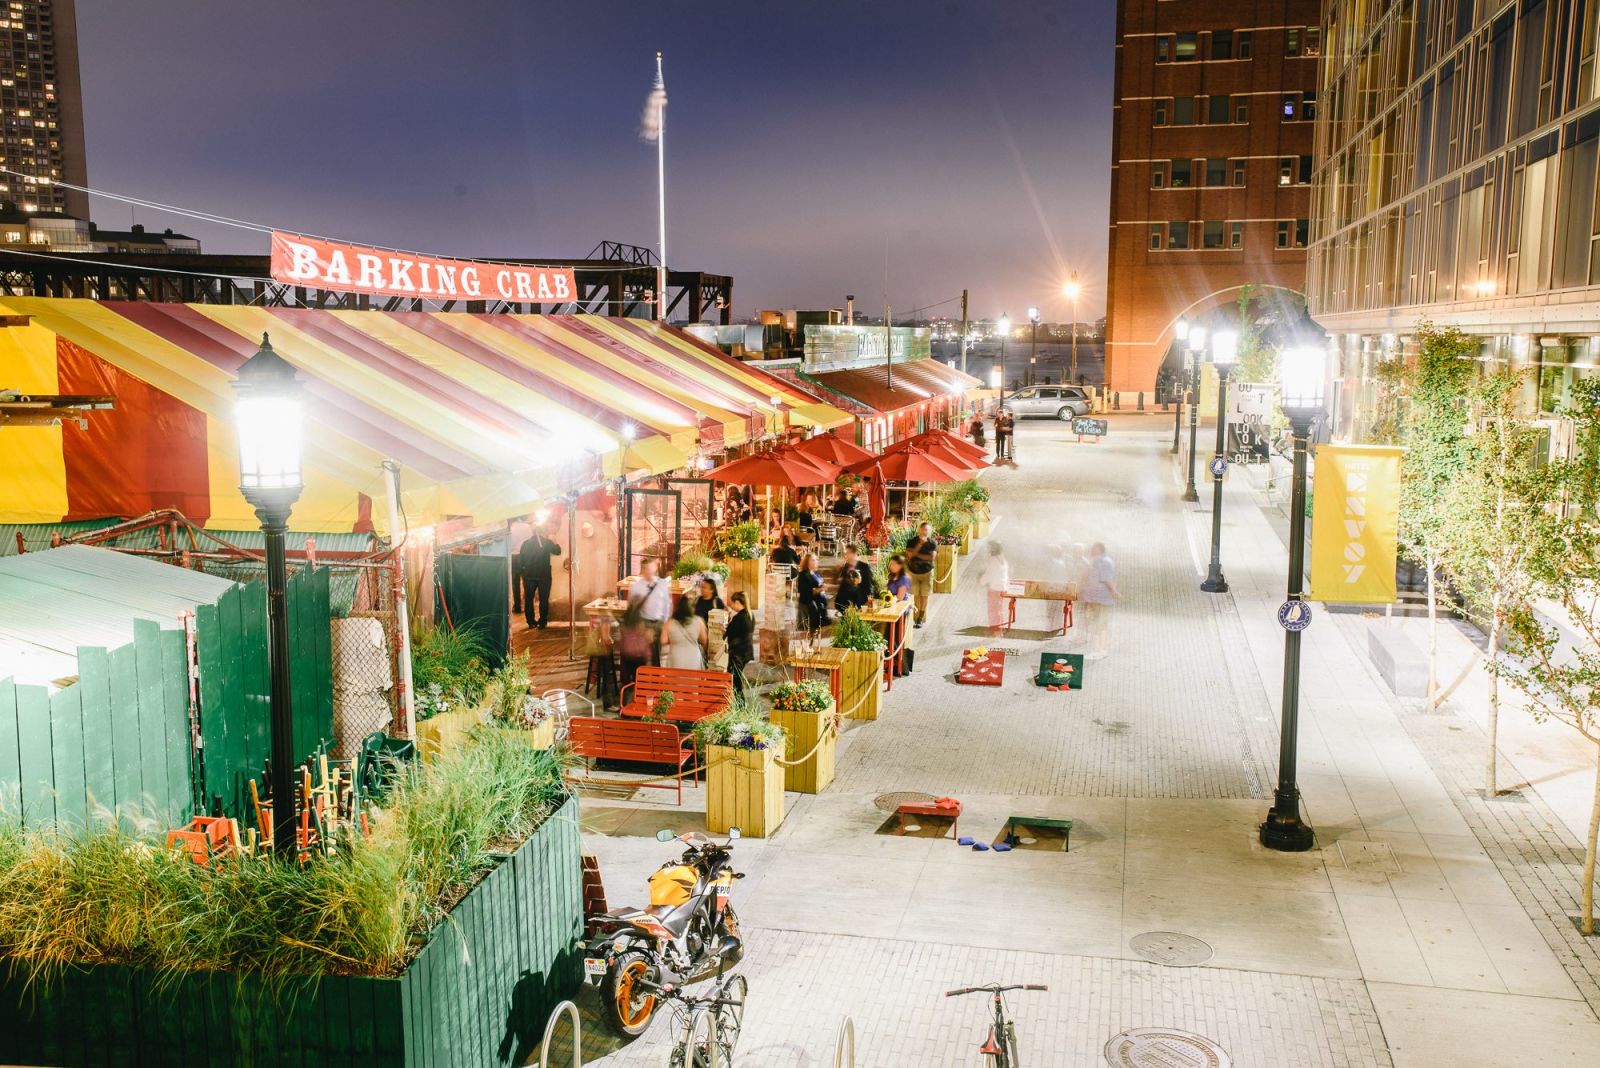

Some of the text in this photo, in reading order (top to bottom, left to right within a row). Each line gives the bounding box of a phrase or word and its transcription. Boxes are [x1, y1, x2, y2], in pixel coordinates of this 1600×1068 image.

[288, 240, 570, 298] BARKING CRAB
[1342, 472, 1368, 583] ENVOY
